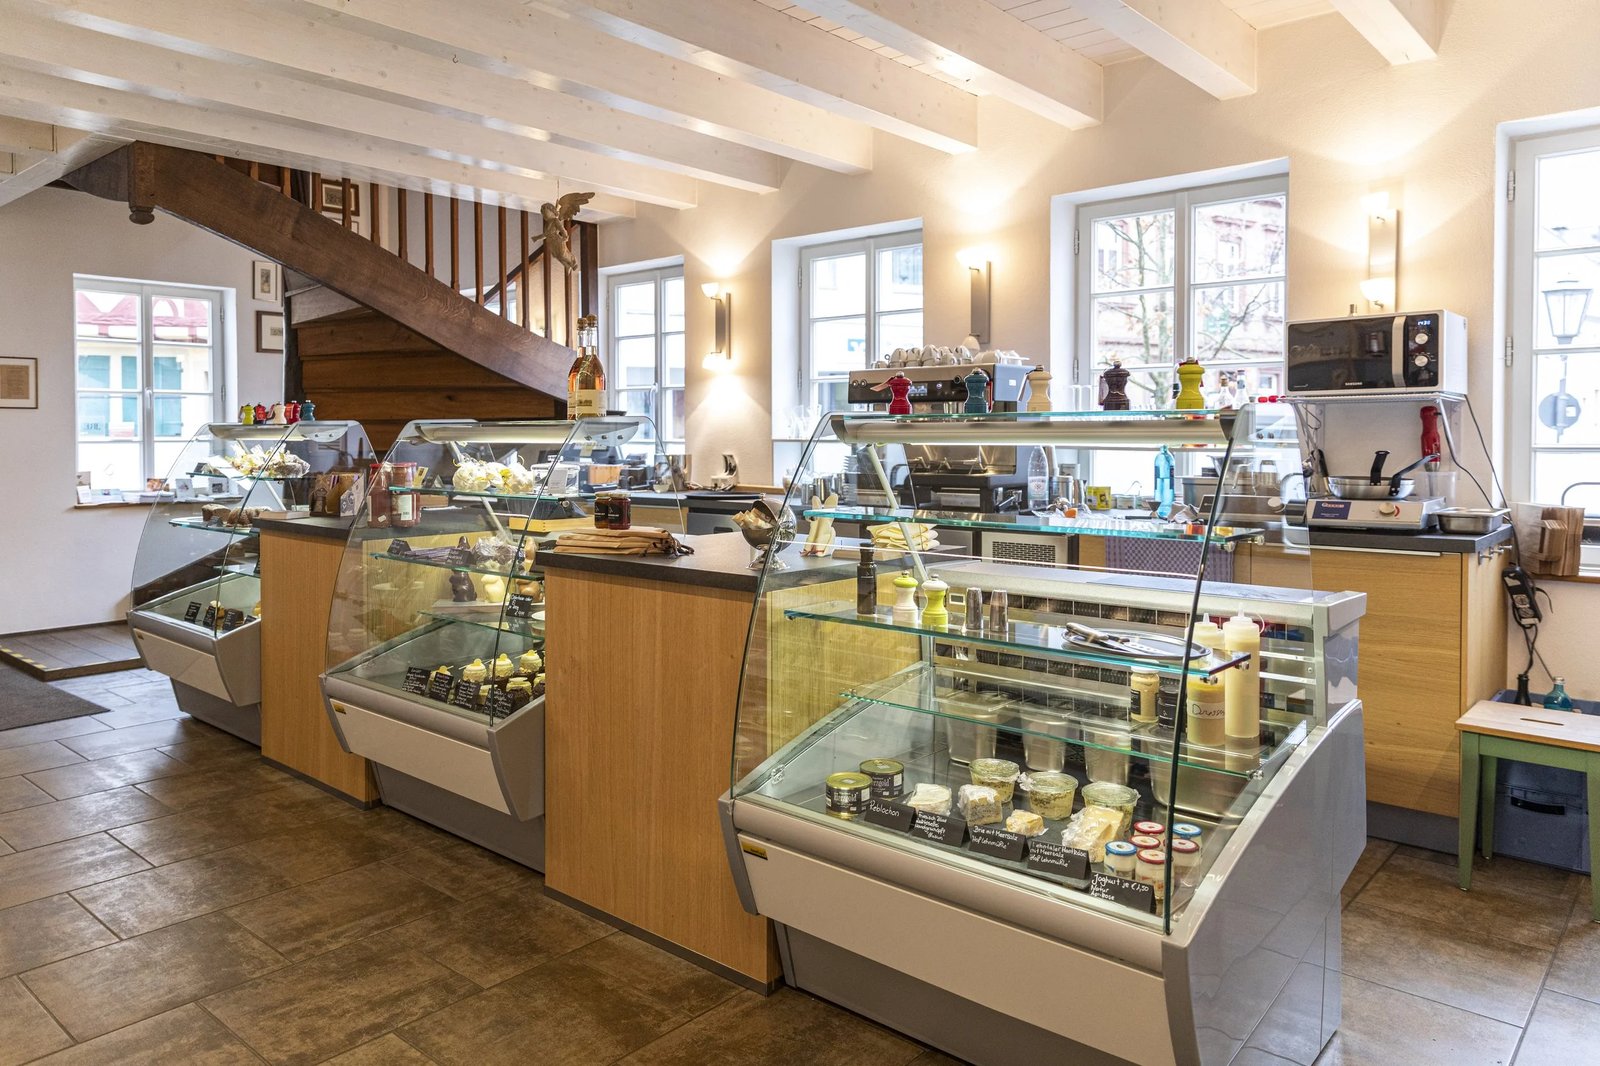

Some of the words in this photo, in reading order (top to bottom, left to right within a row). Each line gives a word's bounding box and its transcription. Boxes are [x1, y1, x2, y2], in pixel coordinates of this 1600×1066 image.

[869, 800, 900, 817] Reblochon
[995, 830, 1018, 841] Meersalz
[1040, 849, 1064, 858] Meersalz
[1091, 873, 1120, 887] Joghurt
